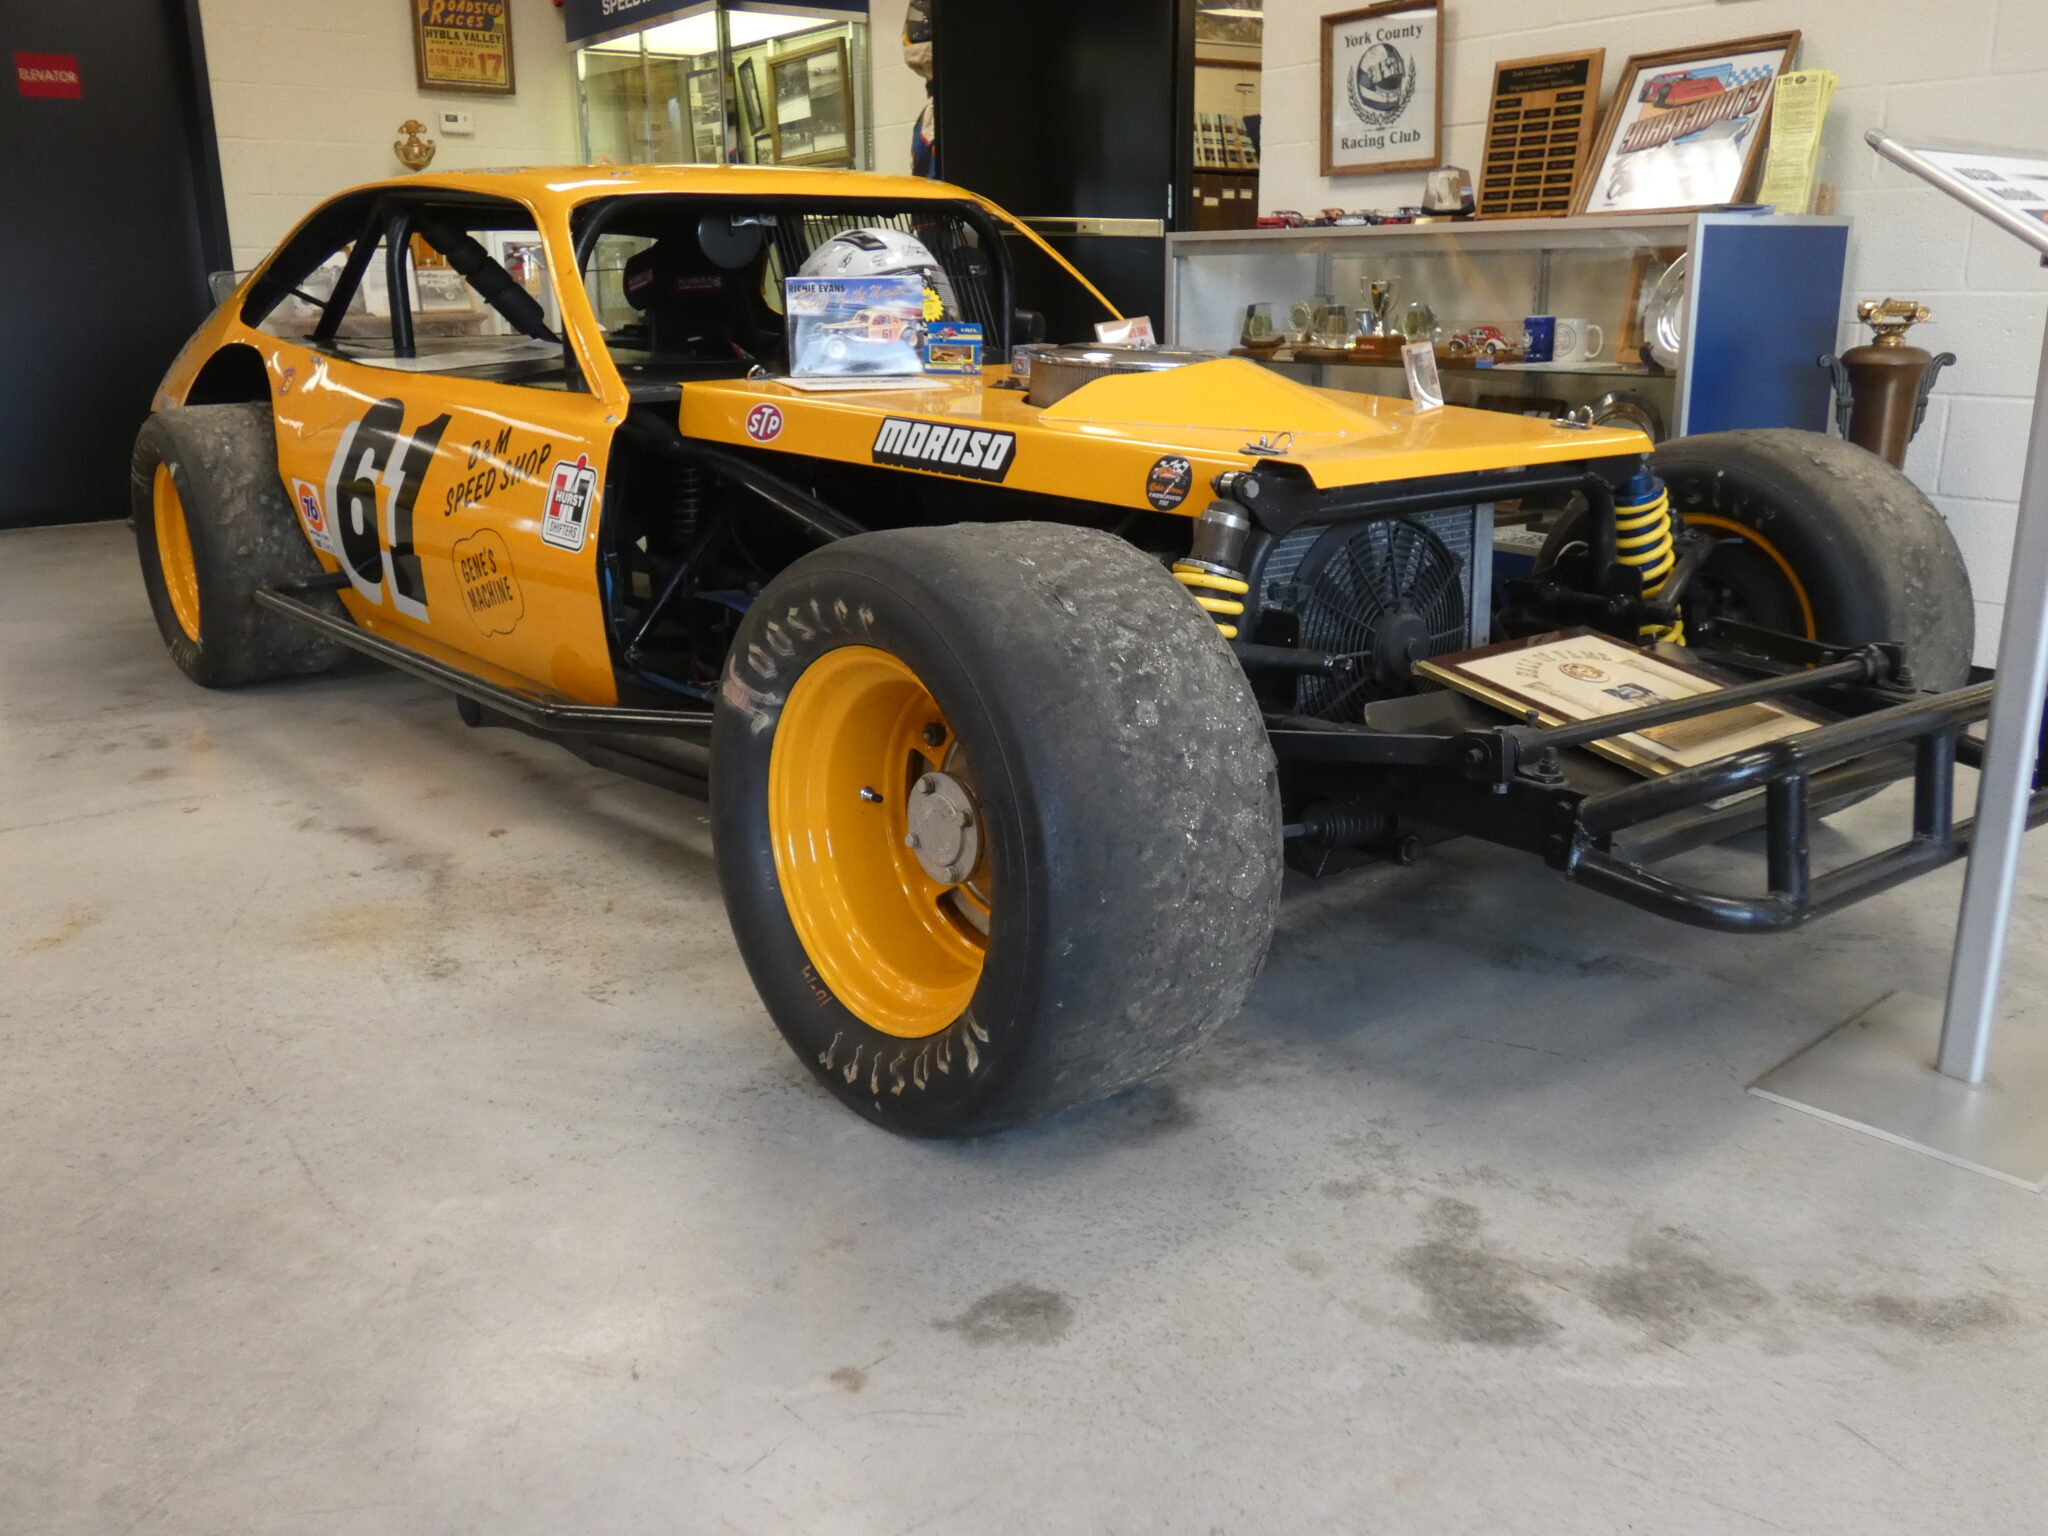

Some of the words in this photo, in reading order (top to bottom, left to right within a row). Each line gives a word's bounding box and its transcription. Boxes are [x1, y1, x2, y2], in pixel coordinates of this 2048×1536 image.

[425, 29, 460, 41] HYBLA
[463, 31, 501, 44] VALLEY
[1344, 32, 1372, 49] York
[1376, 24, 1424, 42] County
[478, 52, 502, 77] 17
[1341, 134, 1385, 151] Racing
[1389, 128, 1421, 145] Club
[788, 283, 817, 294] RICHIE
[819, 284, 846, 294] EVANS
[882, 328, 893, 340] 61
[749, 406, 780, 437] STP
[873, 418, 1014, 471] MOROSO
[444, 467, 497, 517] SPEED
[500, 443, 552, 490] SHOP
[303, 495, 320, 523] 76
[328, 398, 452, 620] 61
[555, 489, 585, 508] HURST
[548, 520, 579, 540] SHIFTERS
[461, 546, 497, 584] GENE'S
[467, 576, 514, 613] MACHINE
